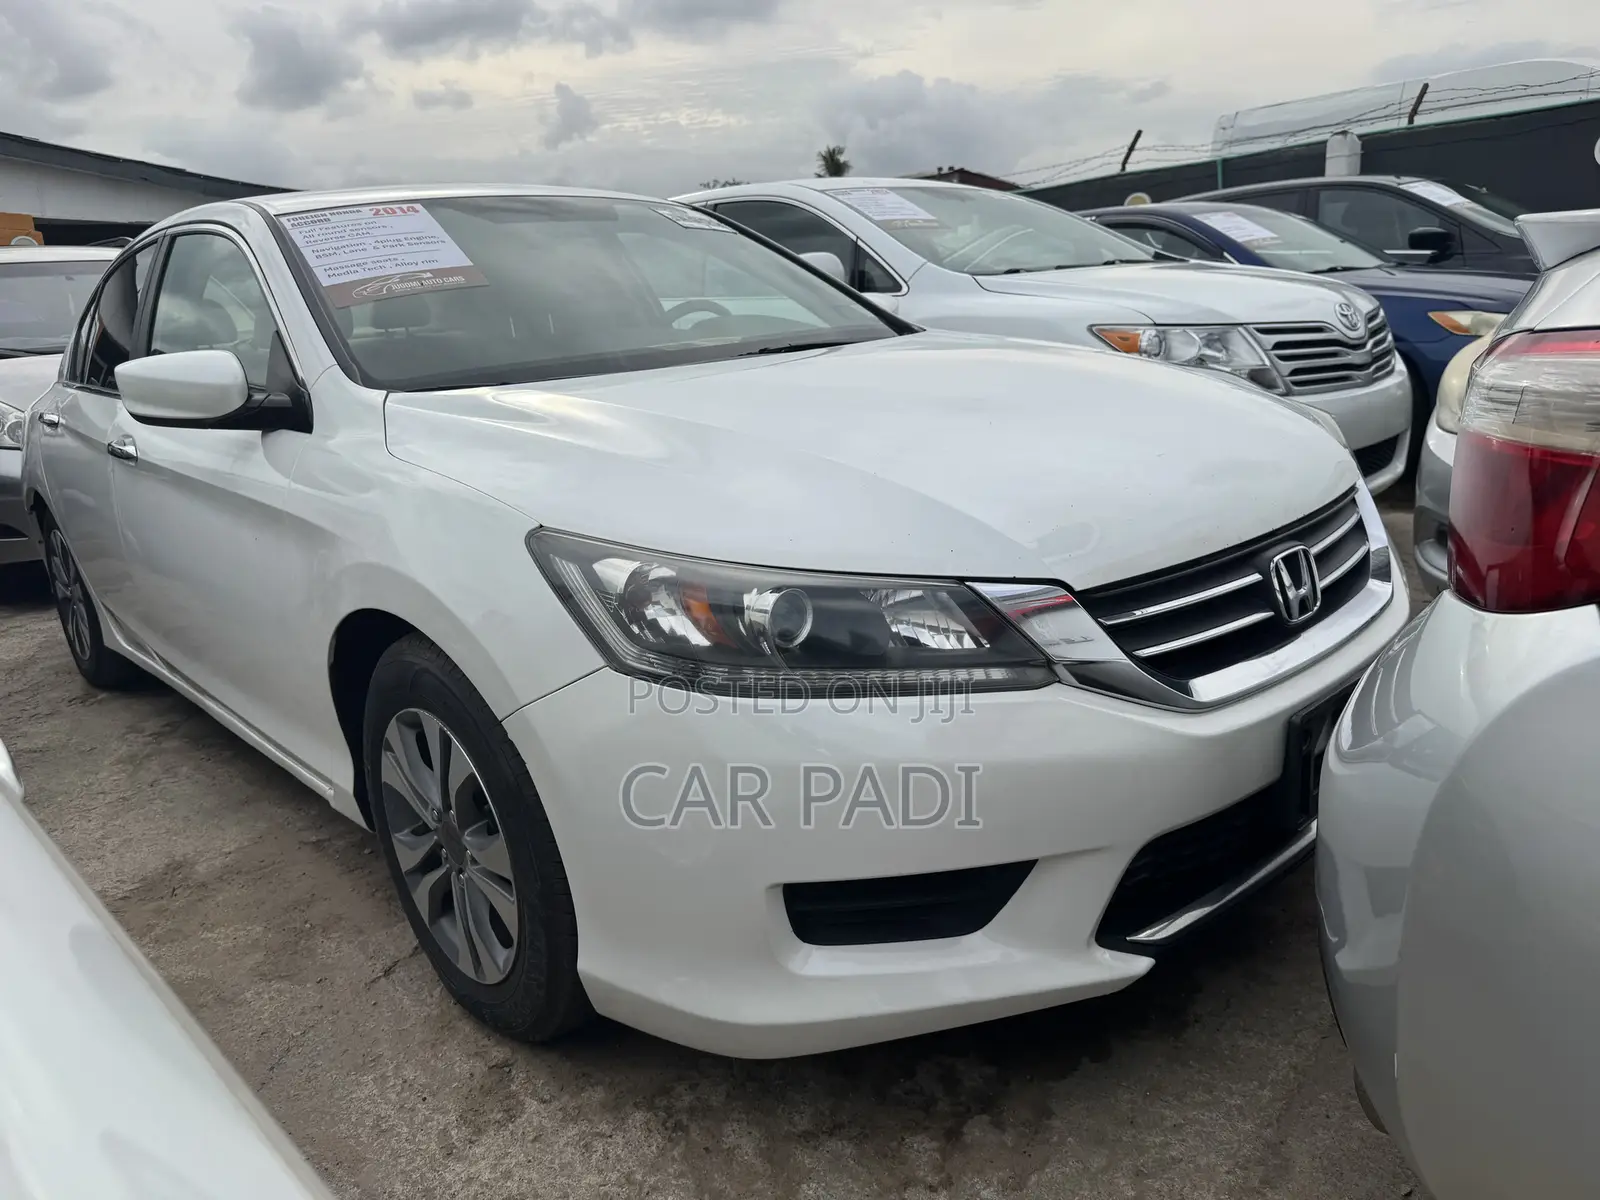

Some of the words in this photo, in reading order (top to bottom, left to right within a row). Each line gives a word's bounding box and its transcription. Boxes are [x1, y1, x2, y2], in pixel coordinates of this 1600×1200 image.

[286, 213, 328, 223] FOREIGN
[329, 209, 362, 217] HONDA
[369, 205, 419, 216] 2014
[290, 218, 332, 228] ACCORD
[299, 226, 317, 235] Full
[302, 232, 315, 240] All
[317, 229, 347, 237] round
[305, 235, 346, 245] Reverse
[323, 261, 368, 273] Massage
[327, 268, 359, 279] Media
[421, 278, 443, 287] AUTO
[443, 275, 465, 283] CARS
